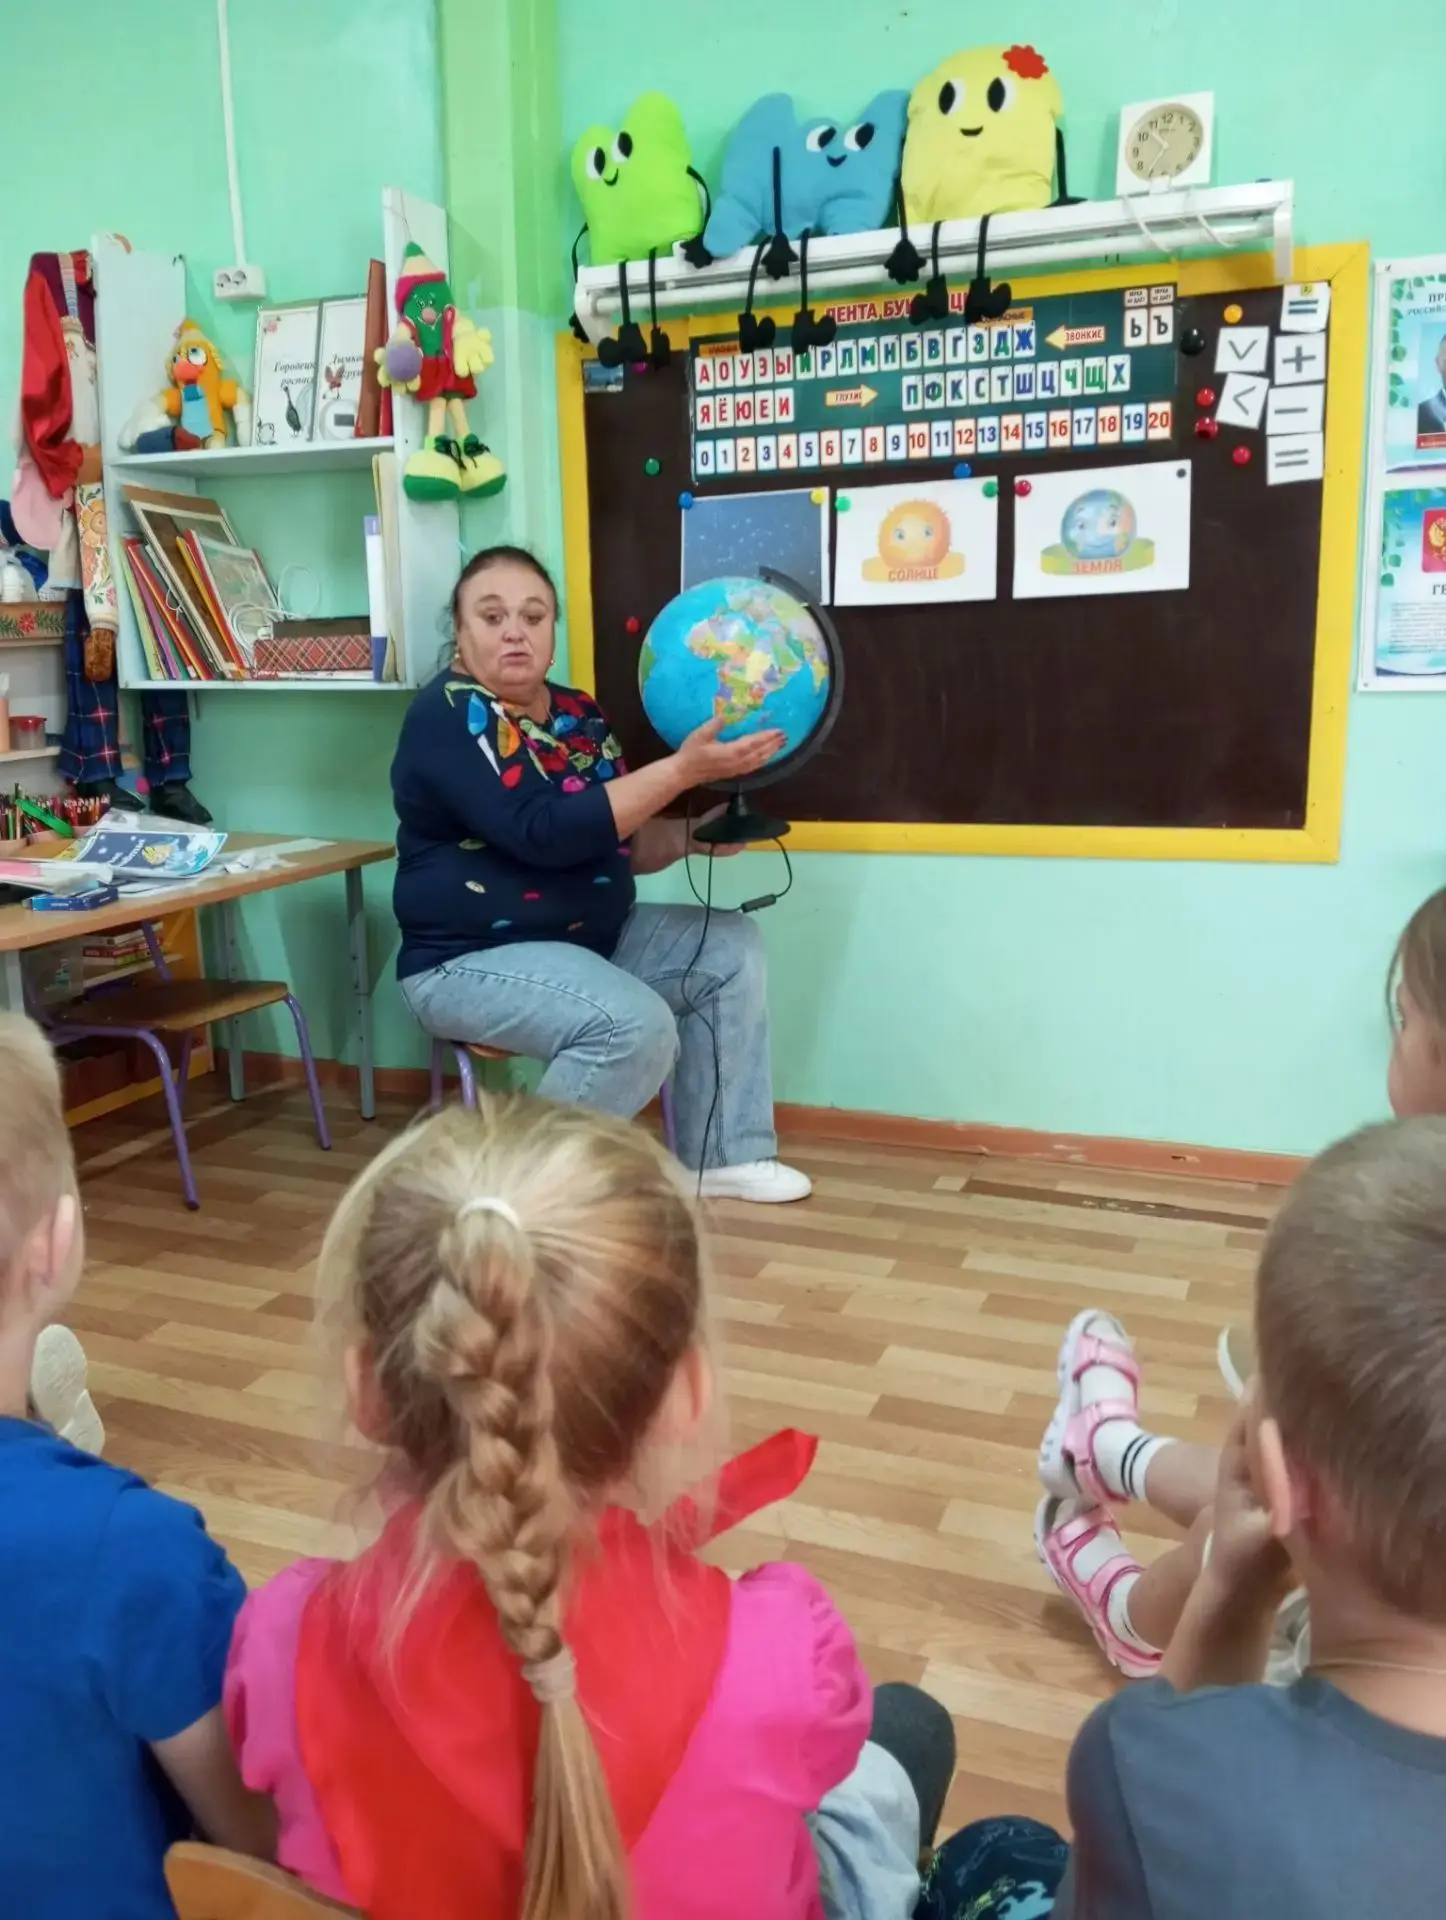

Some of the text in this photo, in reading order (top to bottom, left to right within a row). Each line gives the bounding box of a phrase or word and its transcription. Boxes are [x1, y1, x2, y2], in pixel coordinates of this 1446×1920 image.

[1162, 112, 1173, 124] 12
[1066, 328, 1103, 342] ЗВОНКИЕ
[702, 412, 1170, 466] 0 1 2 3 4 5 6 7 8 9 10 11 12 13 14 15 16 17 18 19 20
[1072, 559, 1122, 574] ЗЕМЛЯ
[888, 568, 940, 582] СОЛНЦЕ
